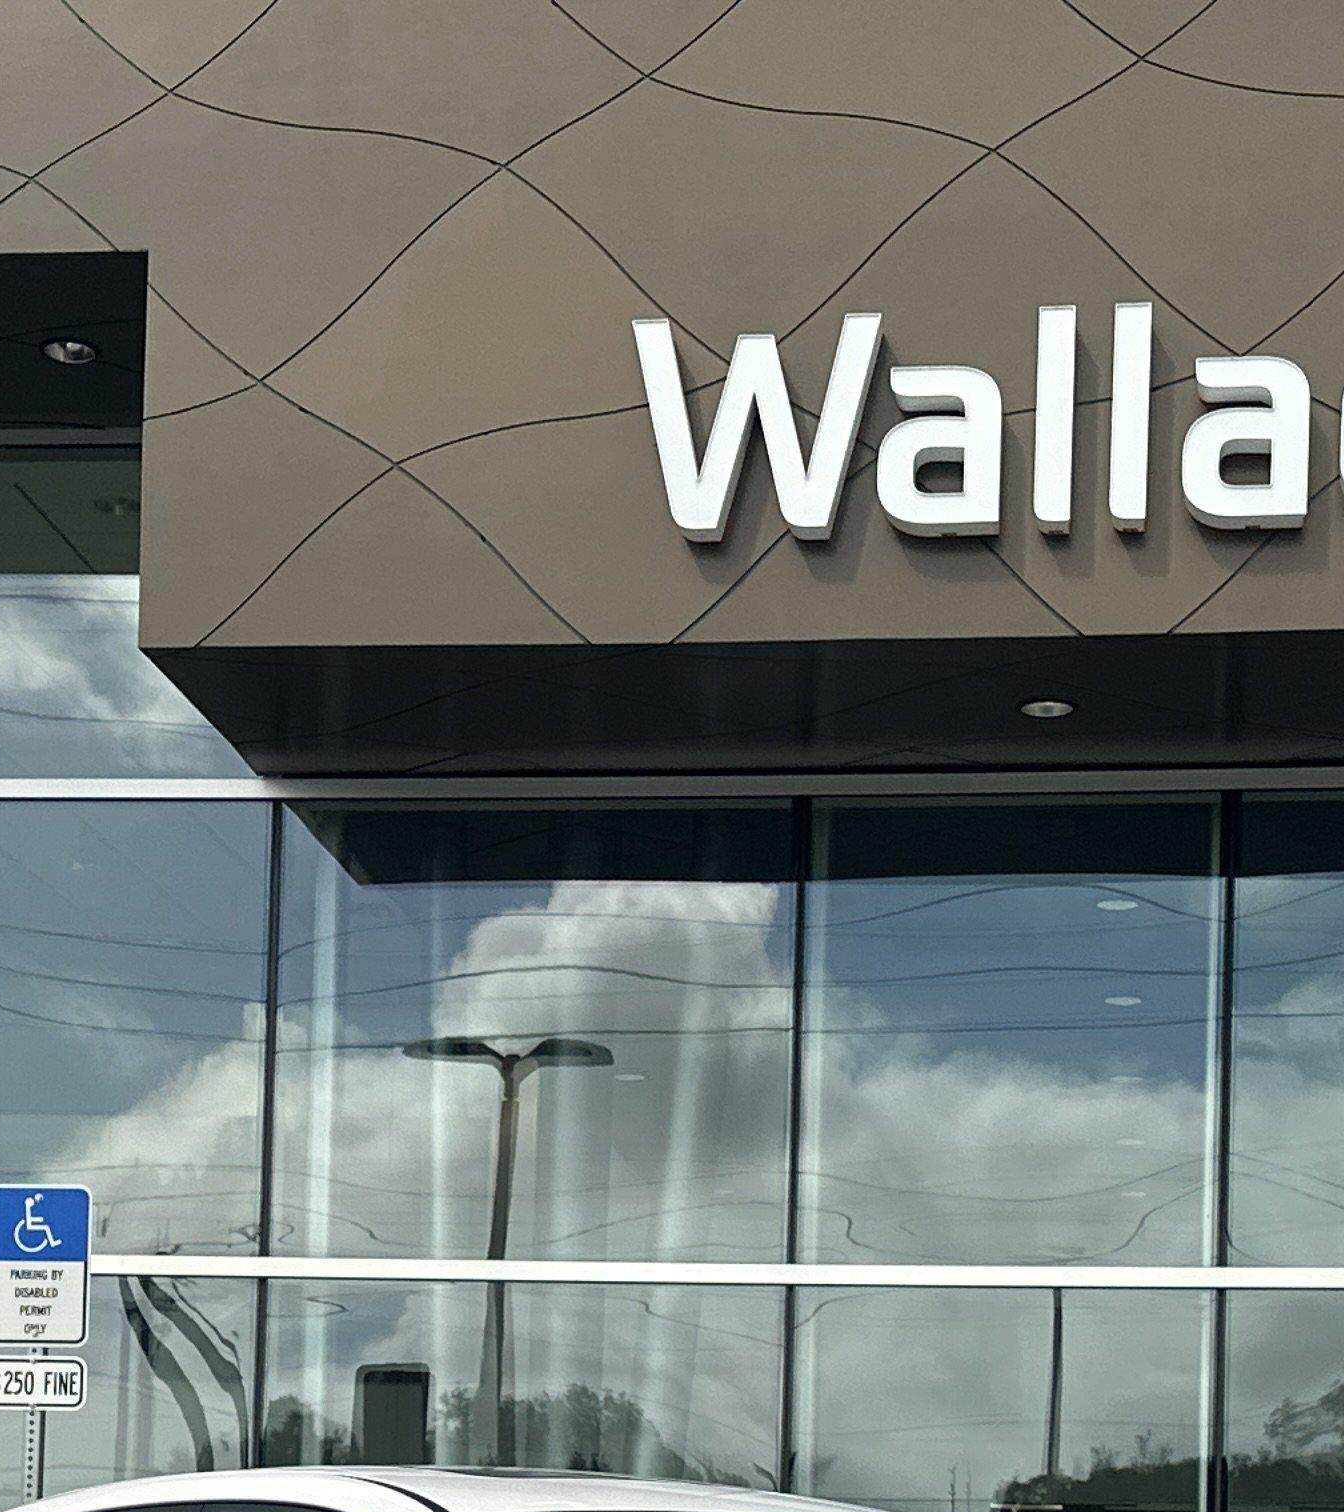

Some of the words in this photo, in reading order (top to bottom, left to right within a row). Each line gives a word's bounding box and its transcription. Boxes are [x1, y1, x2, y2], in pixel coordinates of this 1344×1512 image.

[10, 1269, 48, 1281] PARKING
[51, 1269, 63, 1281] BY
[14, 1287, 58, 1298] DISABLED
[19, 1305, 52, 1316] PERMIT
[23, 1323, 47, 1334] ONLY
[44, 1371, 78, 1395] FINE
